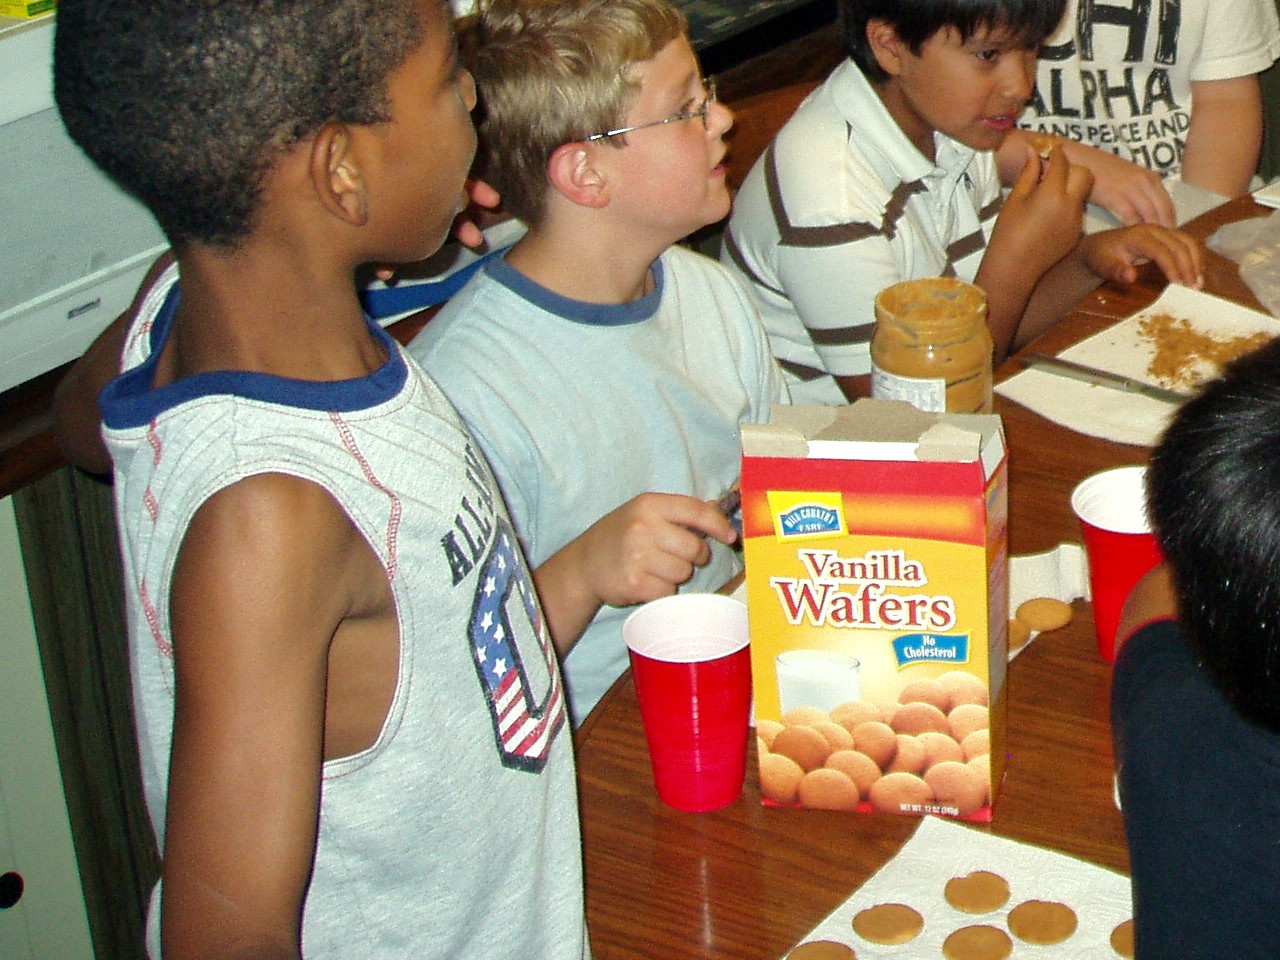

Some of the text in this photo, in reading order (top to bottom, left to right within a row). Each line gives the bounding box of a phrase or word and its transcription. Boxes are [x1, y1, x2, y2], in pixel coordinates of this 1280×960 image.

[1146, 112, 1189, 140] AND
[804, 553, 922, 581] Vanilla
[775, 582, 951, 627] Wafers
[904, 646, 956, 658] Cholesterol
[922, 635, 936, 646] No
